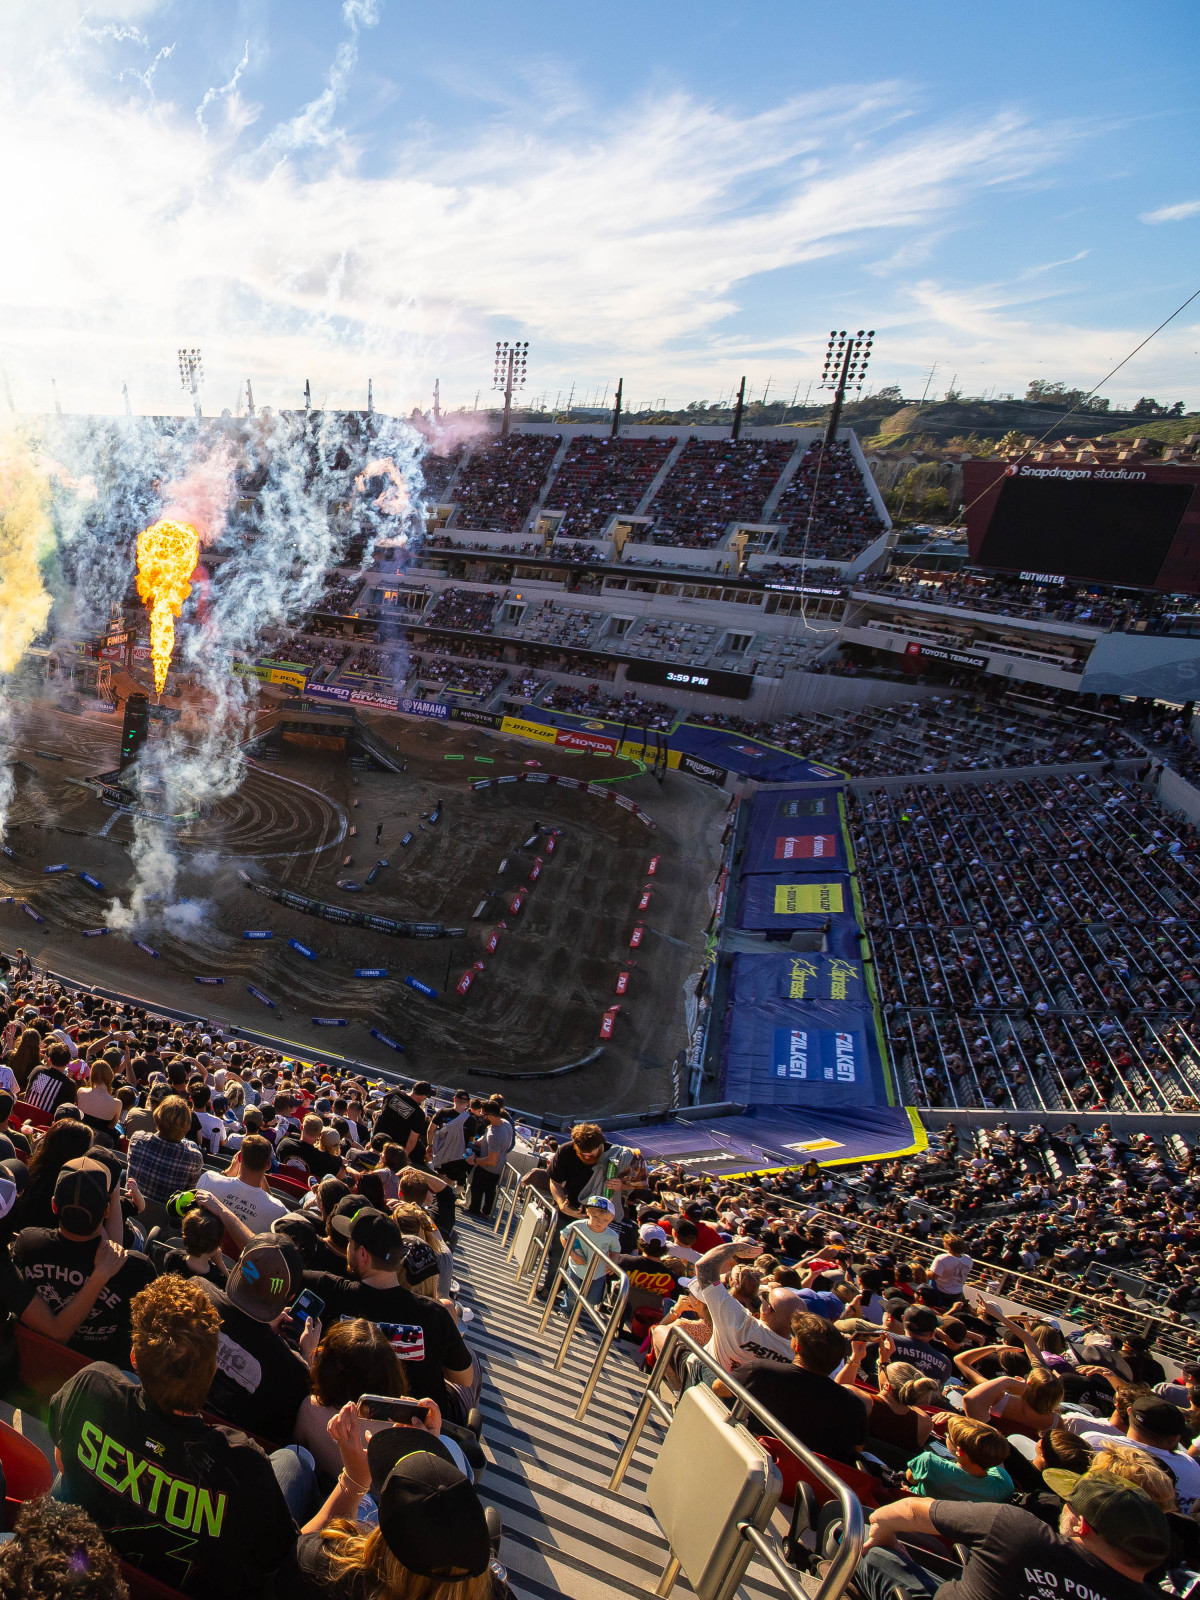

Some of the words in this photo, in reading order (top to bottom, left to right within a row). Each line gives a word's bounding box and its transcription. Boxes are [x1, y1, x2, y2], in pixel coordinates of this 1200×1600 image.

[1019, 465, 1092, 481] Snapdragon
[1093, 468, 1147, 480] stadium
[1019, 571, 1065, 584] CUTWATER
[107, 632, 128, 647] FINISH
[920, 647, 948, 659] TOYOTA
[950, 653, 985, 667] TERRACE
[666, 672, 690, 683] 3:59
[691, 676, 709, 686] PM
[307, 683, 350, 696] FALKEN
[412, 700, 447, 715] YAMAHA
[460, 711, 493, 723] MONSTER
[512, 723, 554, 738] DUNLOP
[570, 737, 614, 752] HONDA
[685, 758, 715, 776] TRIUMPH
[787, 890, 796, 912] DUNLOP
[820, 889, 830, 912] DUNLOP
[789, 1030, 808, 1079] FALKEN
[836, 1032, 856, 1082] FALKEN
[626, 1270, 671, 1289] MOTO
[897, 1346, 947, 1372] FASTHOUSE
[77, 1420, 227, 1538] SEXTON
[1024, 1567, 1058, 1588] AEO
